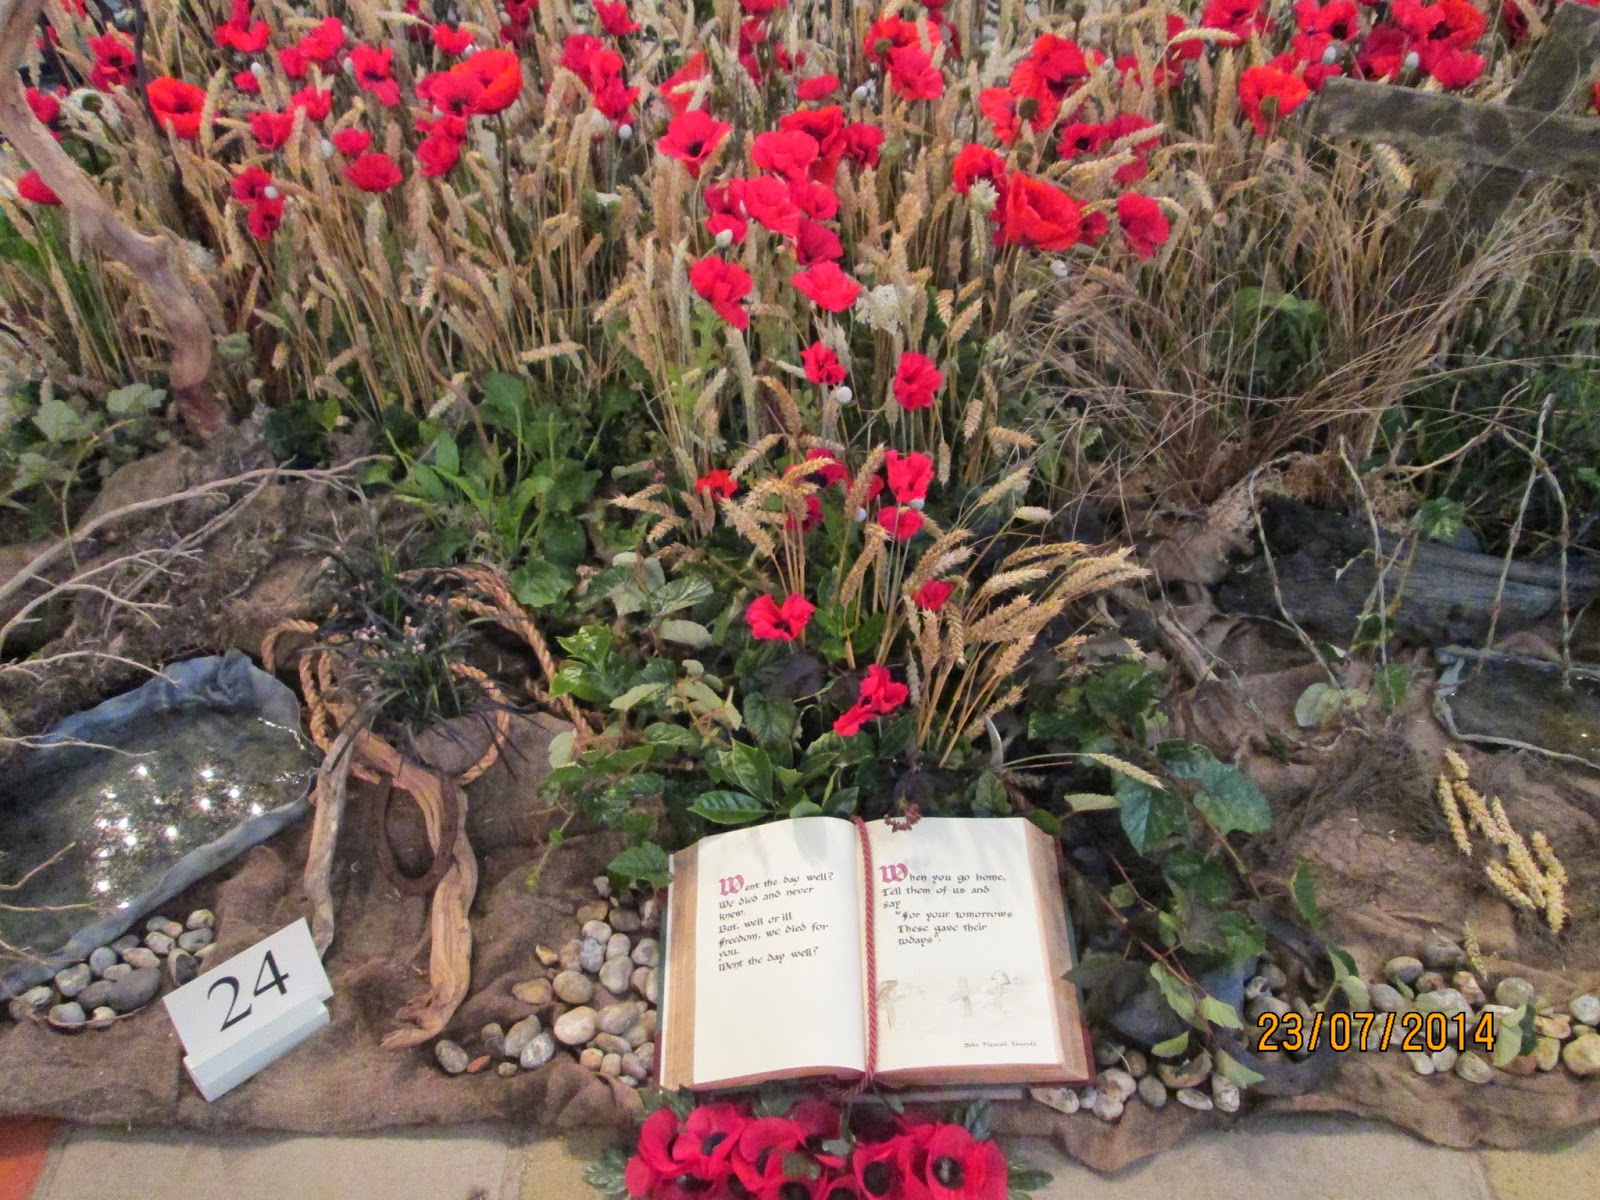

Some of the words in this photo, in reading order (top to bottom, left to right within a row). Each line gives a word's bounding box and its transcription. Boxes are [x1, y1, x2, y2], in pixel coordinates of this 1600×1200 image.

[879, 863, 927, 883] When
[932, 874, 951, 884] you
[957, 874, 970, 883] go
[976, 873, 1006, 882] home,
[719, 874, 760, 896] Went
[764, 876, 778, 887] the
[783, 876, 799, 886] day
[807, 872, 834, 881] well?
[882, 887, 901, 897] Tell
[906, 886, 930, 894] them
[936, 886, 946, 895] of
[719, 900, 734, 909] We
[739, 895, 758, 906] died
[763, 891, 780, 900] and
[786, 886, 814, 896] never
[883, 900, 901, 909] say
[719, 910, 746, 921] knew.
[744, 918, 763, 927] well
[768, 915, 779, 924] or
[782, 912, 792, 921] ill
[926, 911, 950, 921] your
[955, 911, 1013, 919] tomorrows
[766, 928, 780, 937] we
[785, 923, 806, 933] died
[812, 922, 829, 932] for
[897, 925, 929, 933] These
[934, 925, 958, 933] gave
[963, 923, 987, 931] their
[719, 948, 739, 961] you.
[719, 961, 743, 972] Went
[748, 955, 763, 965] the
[767, 953, 785, 964] day
[791, 947, 818, 958] well?
[207, 950, 289, 1032] 24
